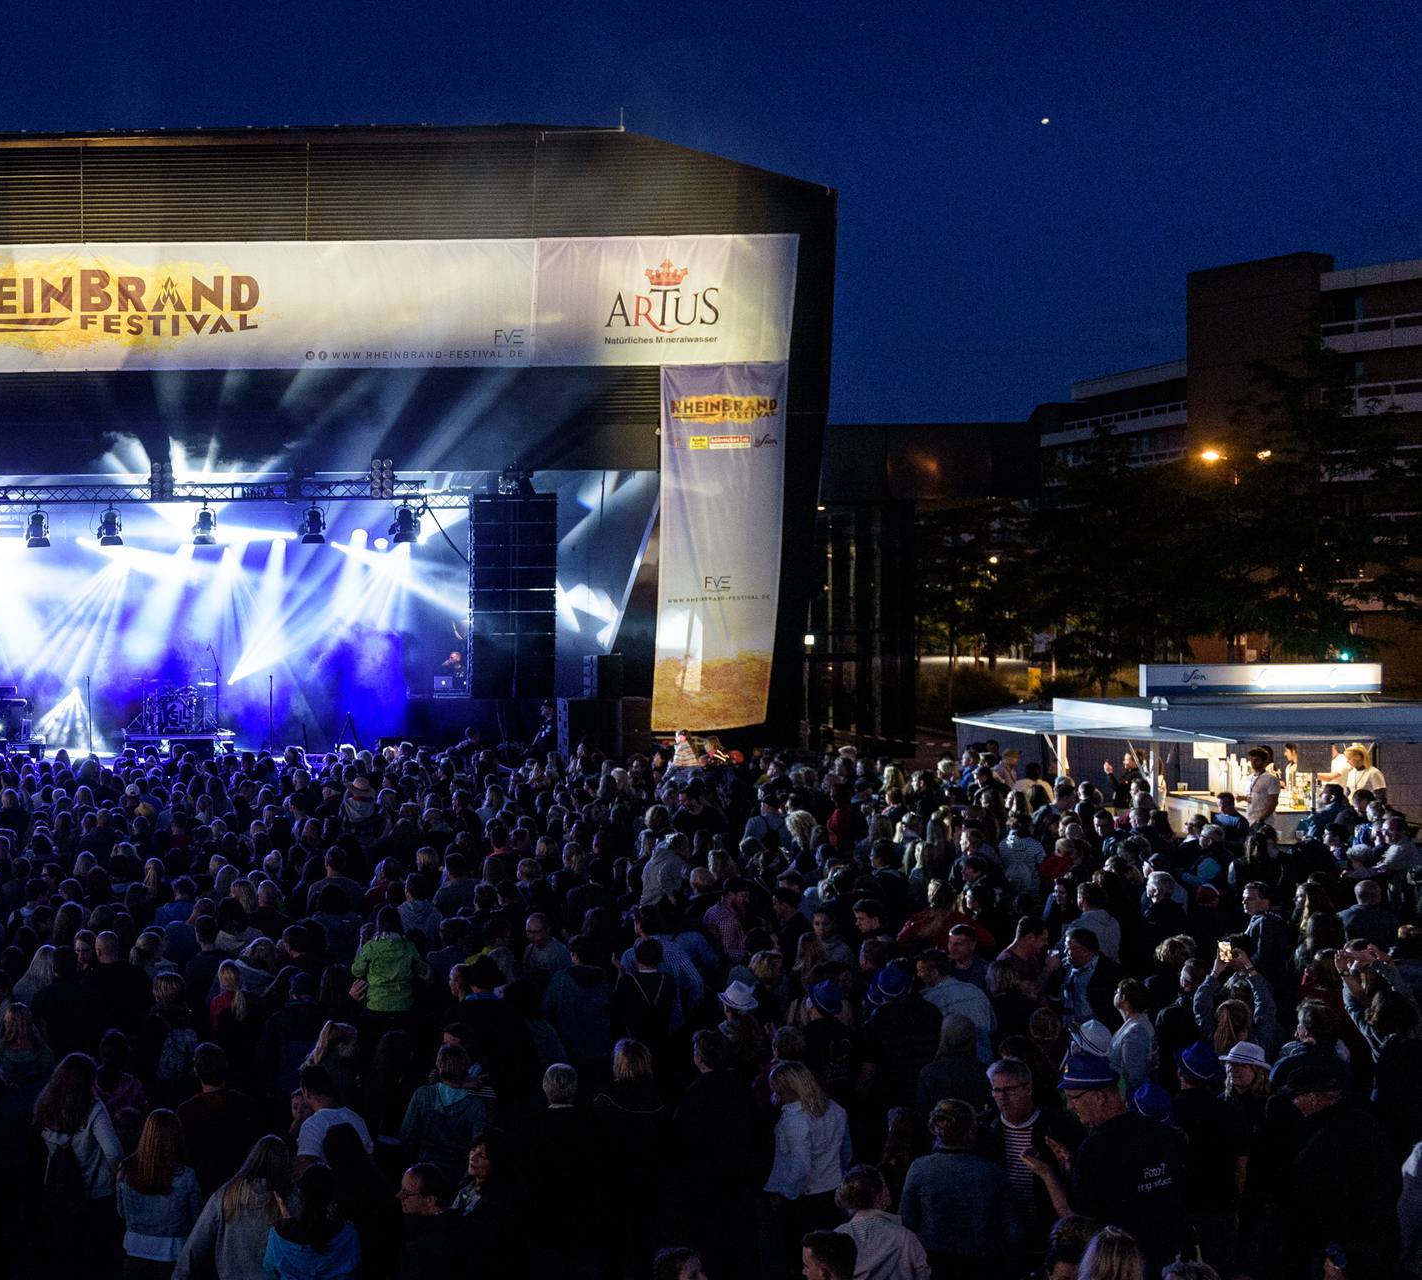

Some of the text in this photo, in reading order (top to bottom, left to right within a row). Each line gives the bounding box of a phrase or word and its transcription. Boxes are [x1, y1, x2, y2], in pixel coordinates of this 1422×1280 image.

[605, 287, 720, 334] ARTUS
[79, 313, 259, 337] FESTIVAL
[494, 329, 524, 345] FVE
[604, 335, 718, 345] Natürliches Mineralwasser
[332, 349, 524, 361] WWW.RHEINBRAND-FESTIVALDE
[704, 576, 731, 590] FVE
